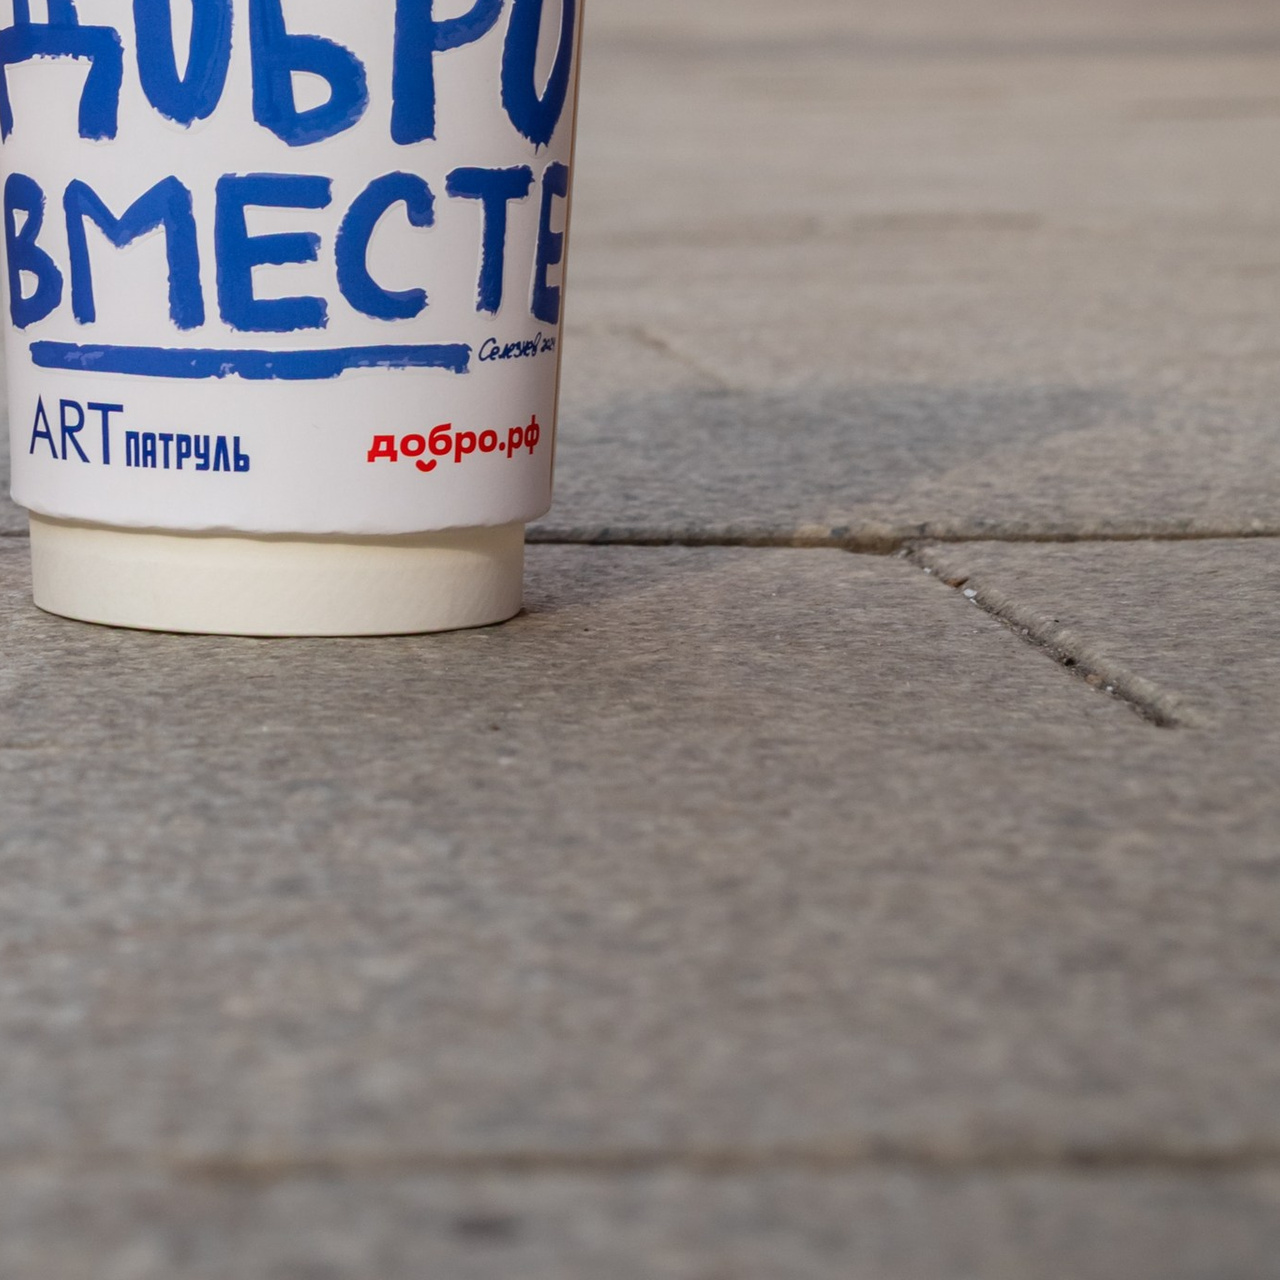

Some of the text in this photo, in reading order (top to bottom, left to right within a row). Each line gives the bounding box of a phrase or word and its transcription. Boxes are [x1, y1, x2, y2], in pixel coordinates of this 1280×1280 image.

[2, 161, 570, 333] ВМЕСТЕ
[29, 393, 251, 474] ART ПАТРУЛЬ
[366, 413, 542, 467] добро.рф
